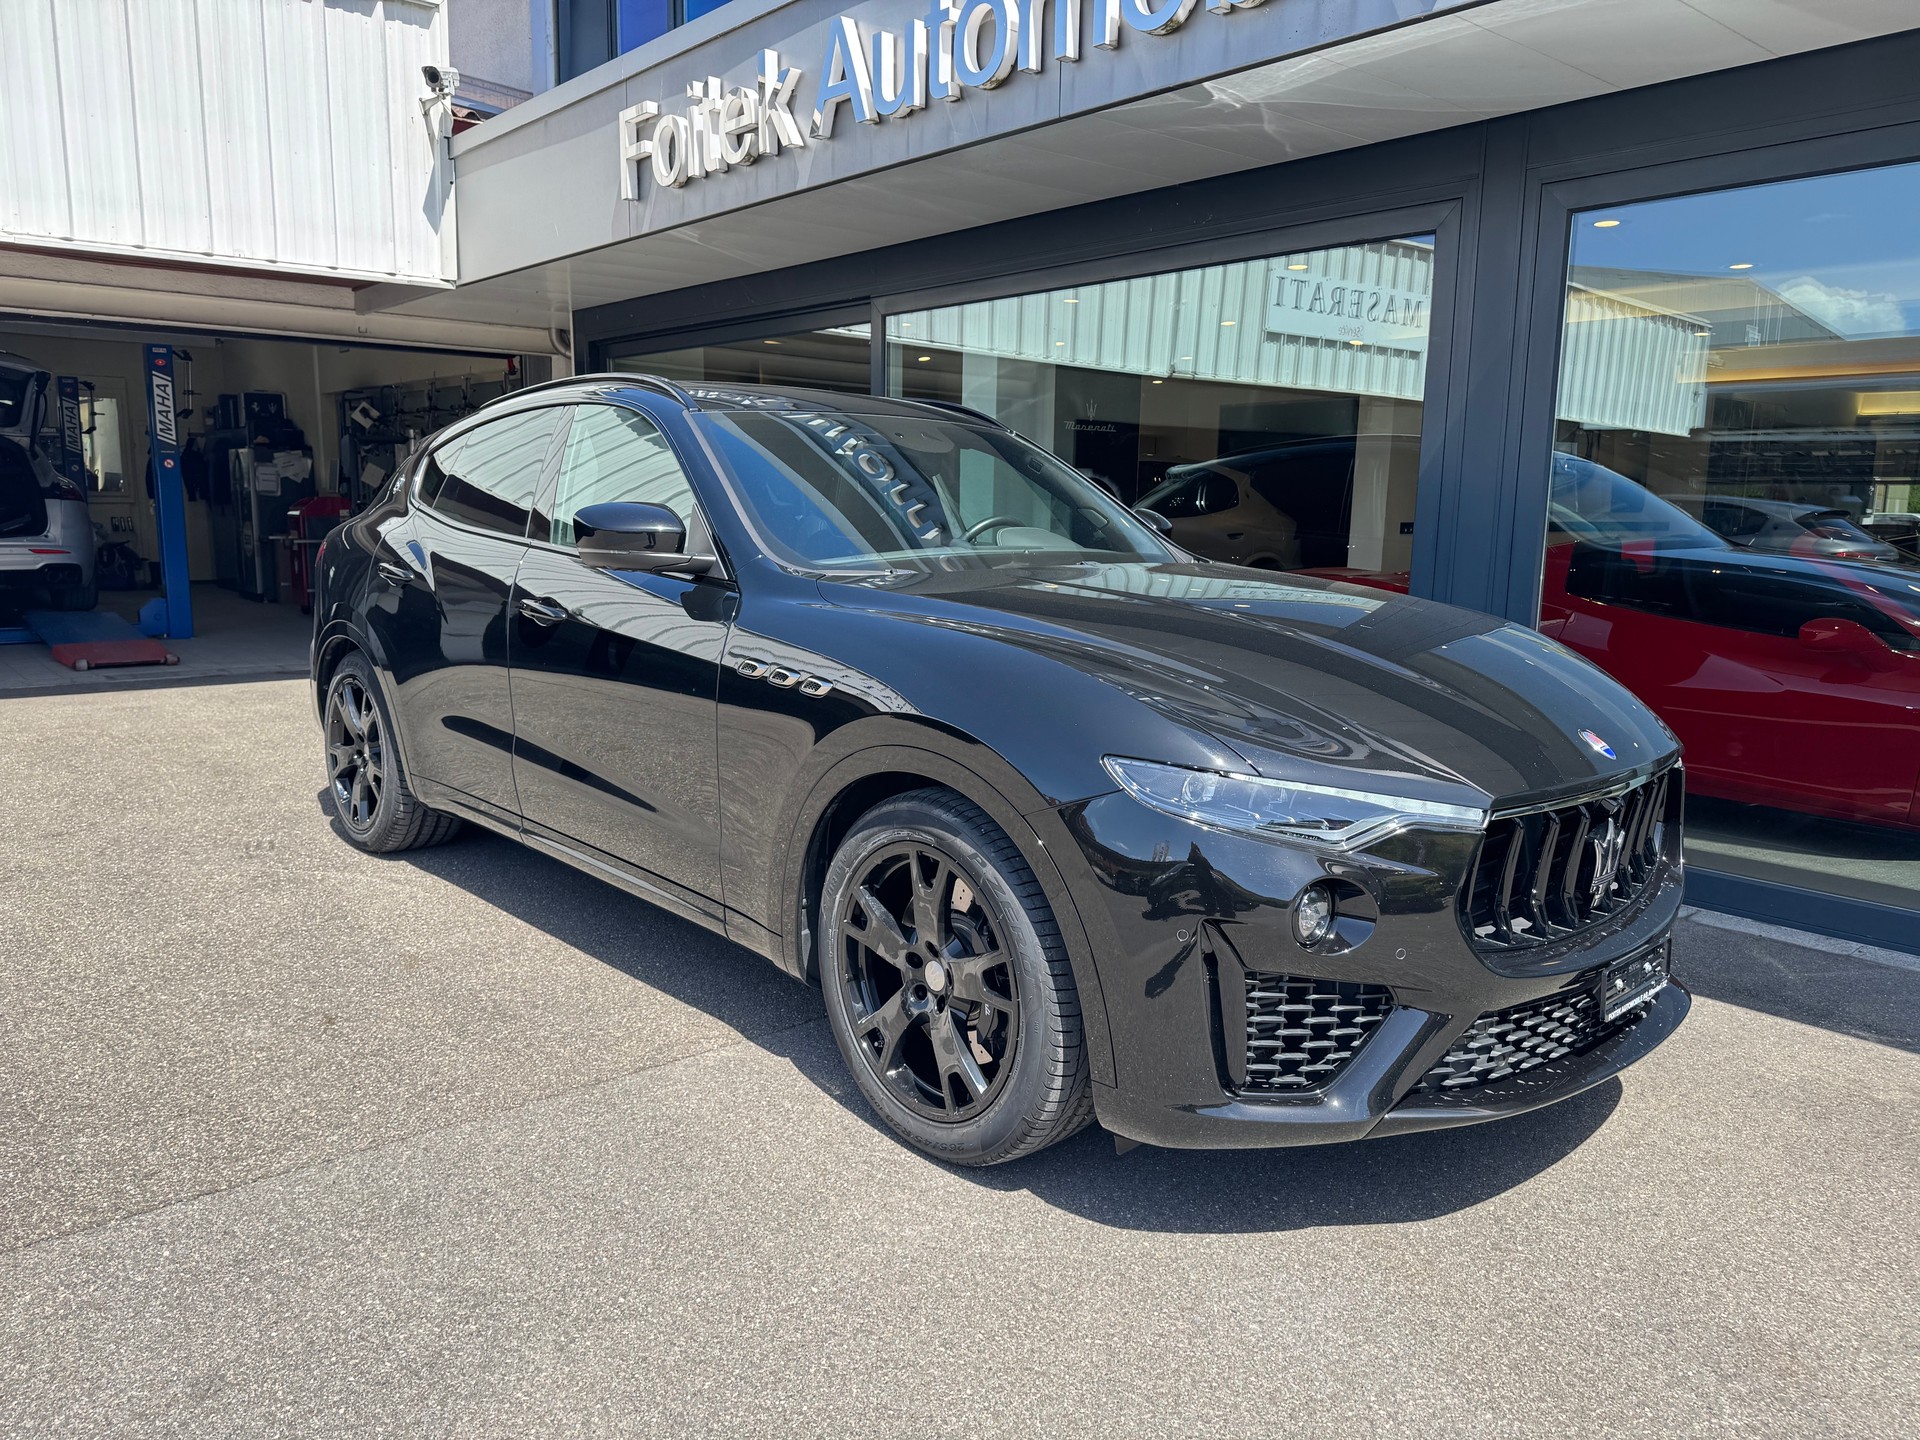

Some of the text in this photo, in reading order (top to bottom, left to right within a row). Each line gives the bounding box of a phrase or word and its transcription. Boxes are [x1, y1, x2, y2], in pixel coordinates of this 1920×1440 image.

[619, 48, 804, 200] Foitek
[65, 406, 79, 446] MAHA
[155, 383, 174, 437] MAHA
[1064, 420, 1117, 432] Maserati
